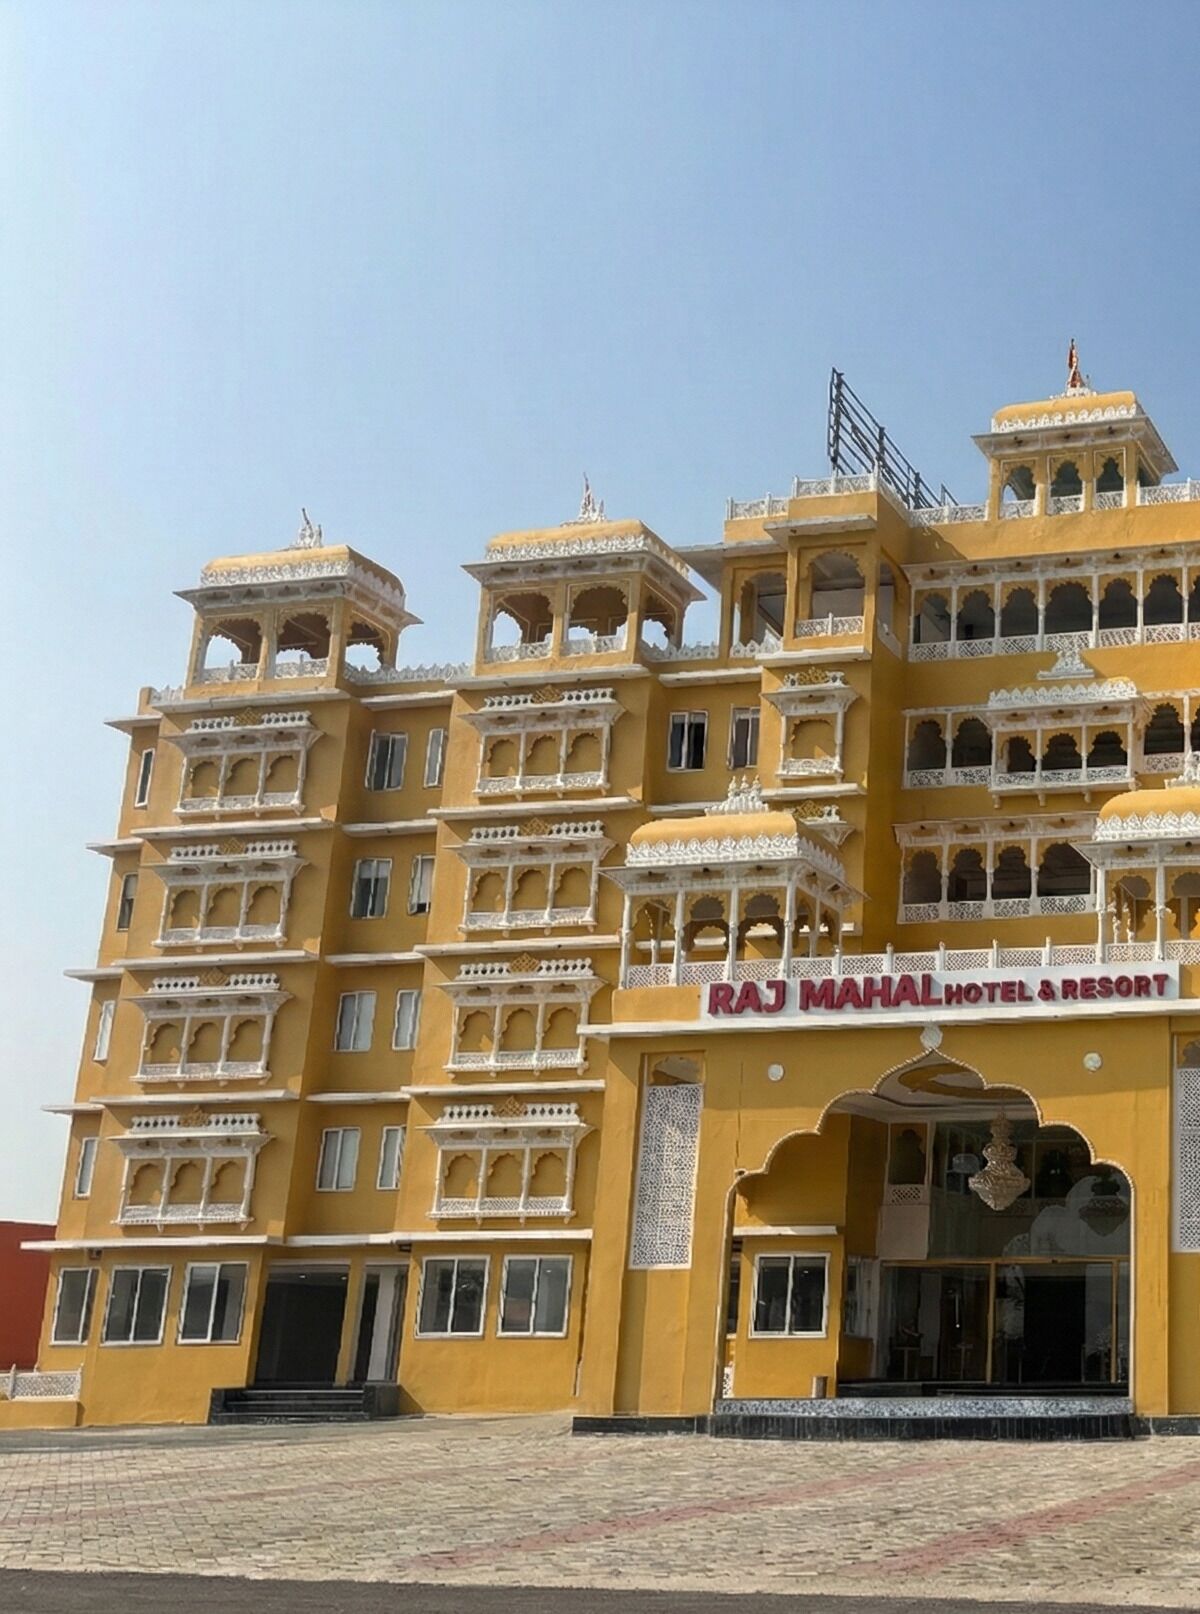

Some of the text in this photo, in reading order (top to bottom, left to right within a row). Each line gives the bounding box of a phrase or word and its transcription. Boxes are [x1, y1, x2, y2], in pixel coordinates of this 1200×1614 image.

[708, 974, 1169, 1015] RAJ MAHAL HOTEL & RESORT
